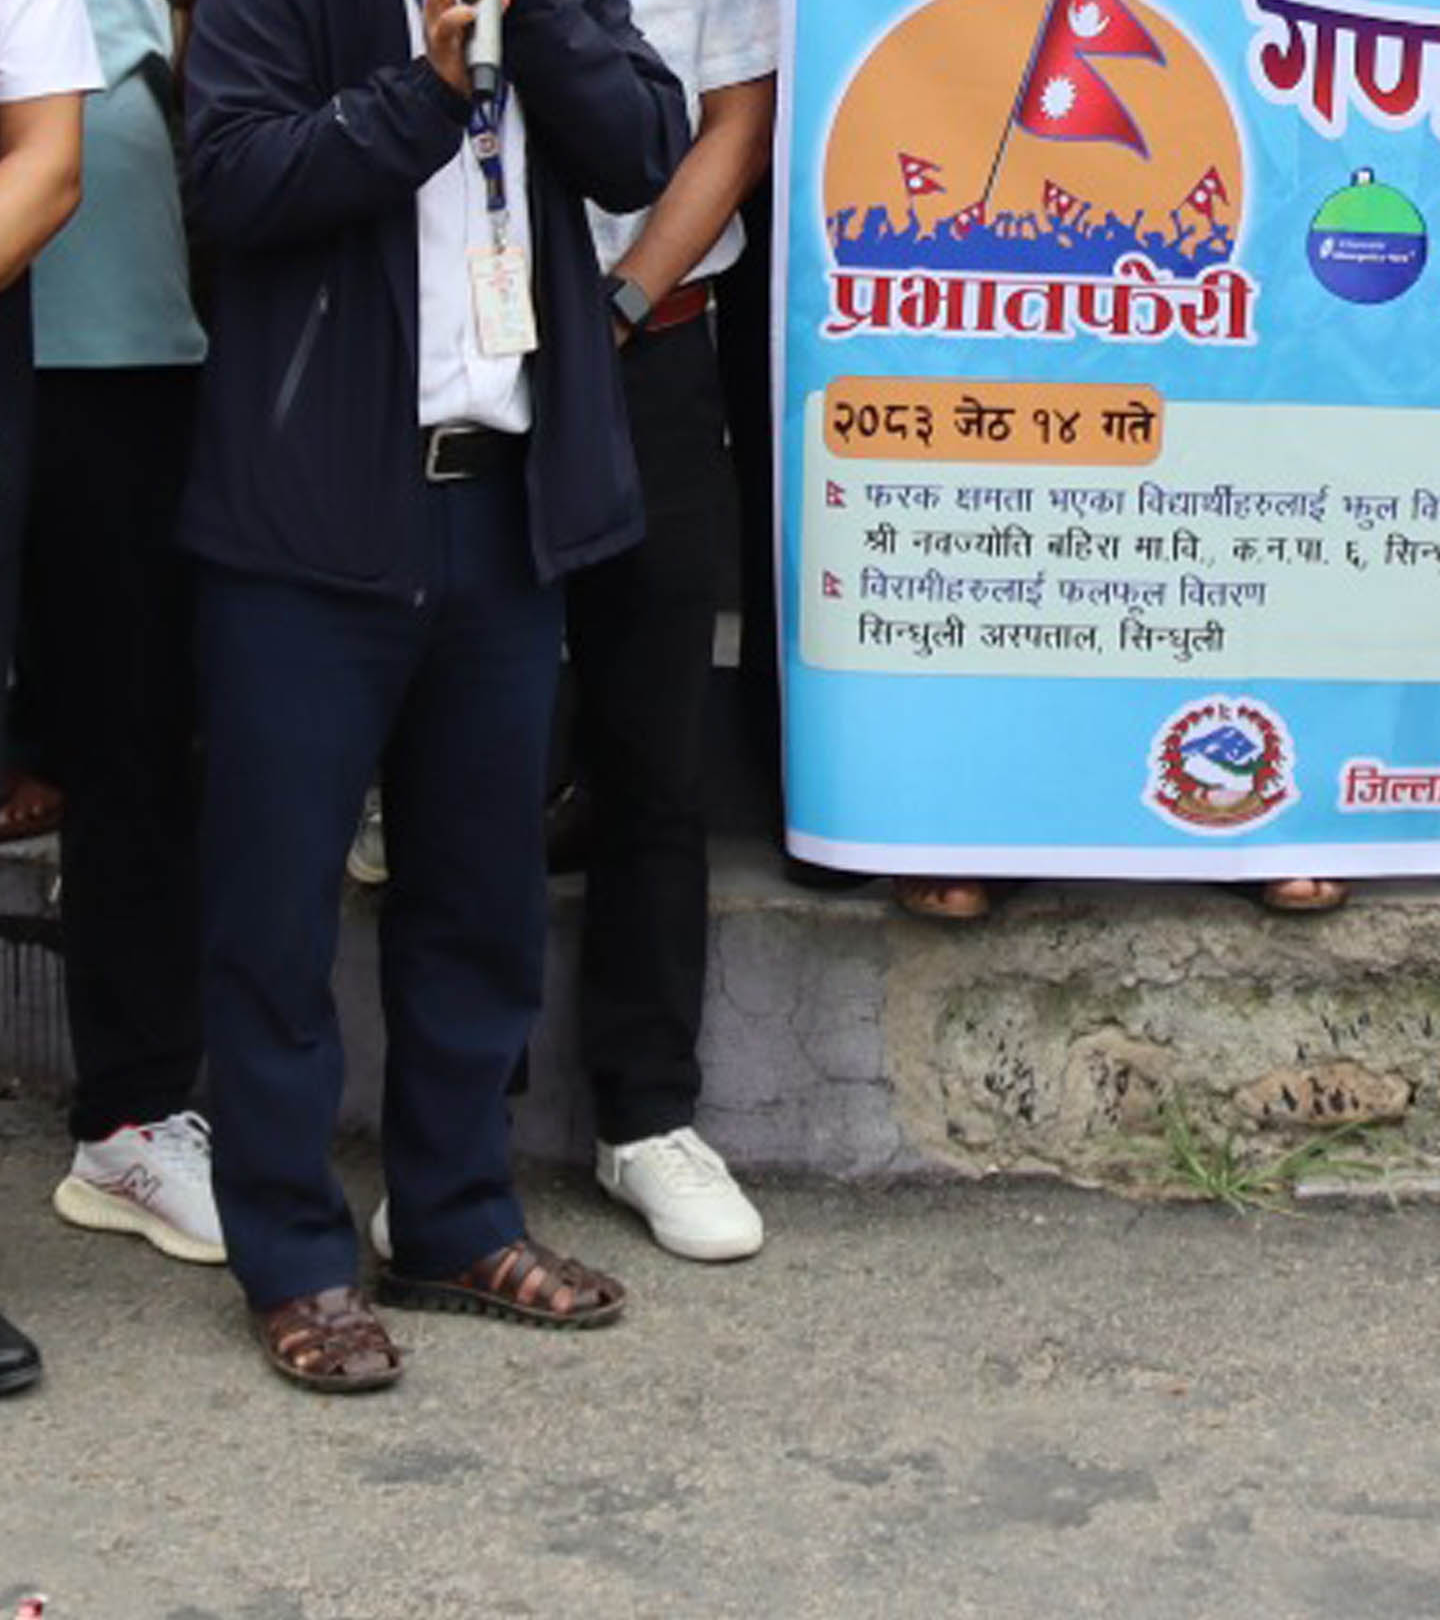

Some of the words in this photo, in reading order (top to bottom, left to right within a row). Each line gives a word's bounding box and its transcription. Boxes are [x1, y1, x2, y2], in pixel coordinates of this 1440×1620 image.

[827, 260, 1254, 340] प्रभातफेरी
[833, 402, 933, 447] २०८३
[954, 397, 1015, 442] जेठ
[1032, 409, 1081, 444] १४
[1101, 401, 1157, 443] गते
[864, 484, 942, 512] फरक
[956, 486, 1033, 514] क्षमता
[1049, 486, 1124, 519] भएका
[863, 523, 897, 557] श्री
[912, 526, 1033, 559] नवज्योति
[1047, 529, 1120, 560] बहिरा
[1179, 574, 1267, 608] वितरण
[858, 612, 965, 658] सिन्धुली
[1118, 619, 1225, 663] सिन्धुली
